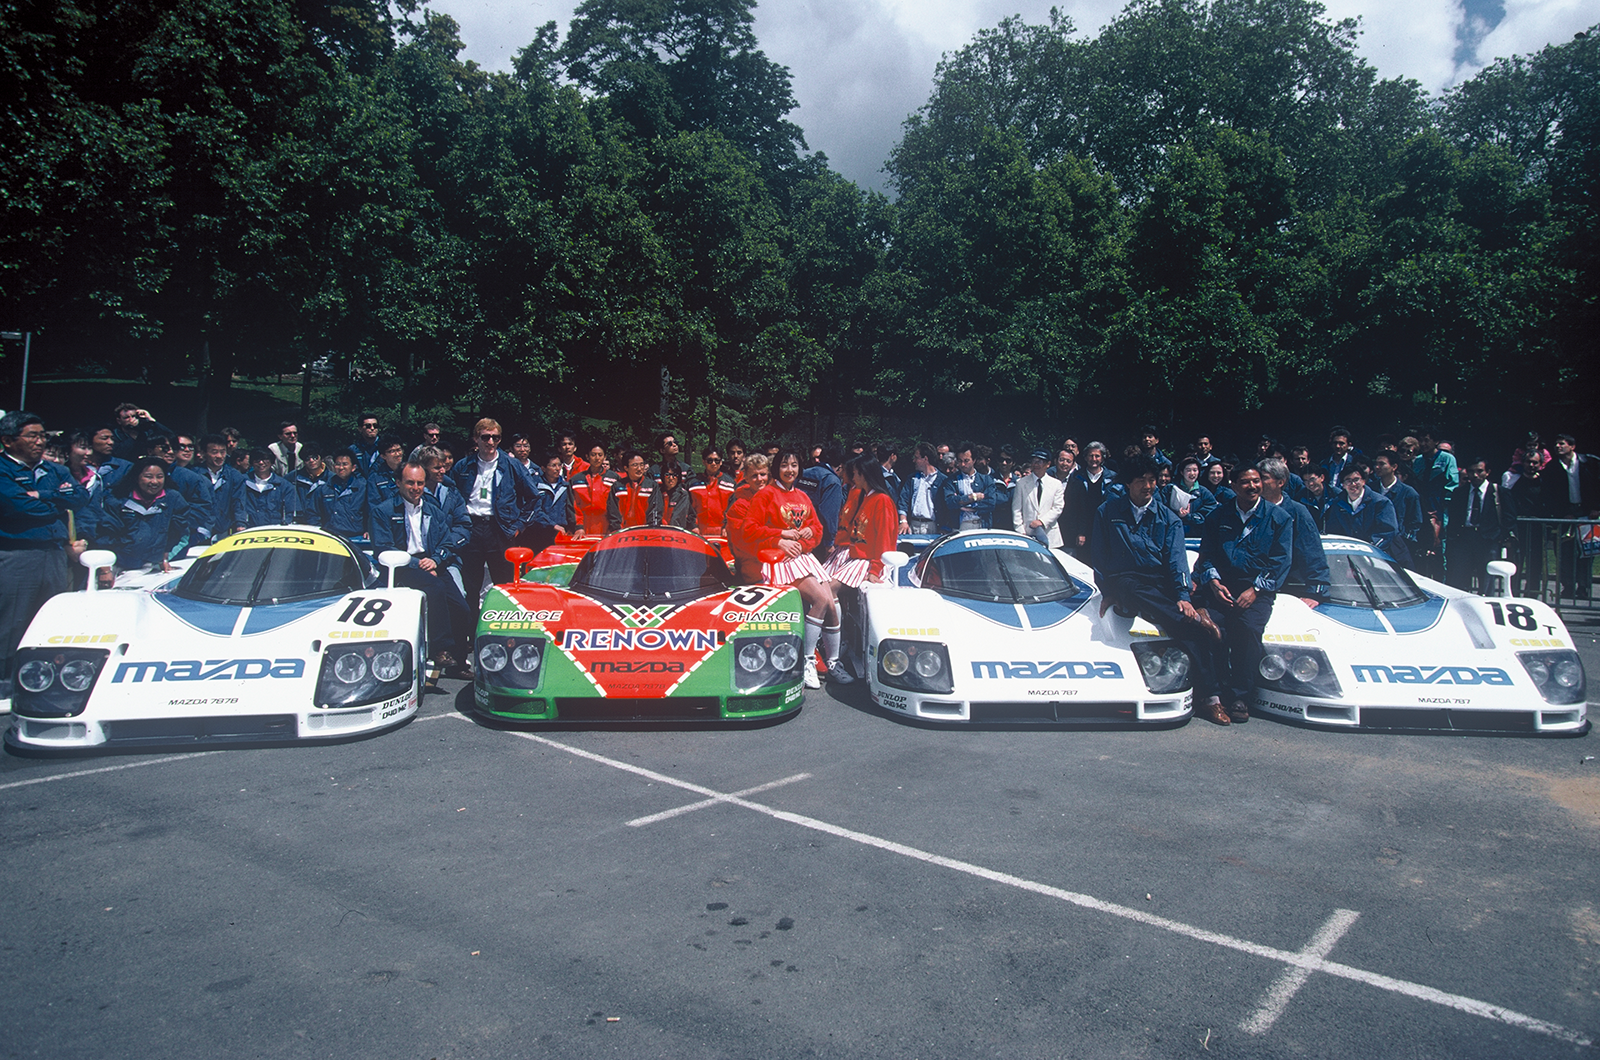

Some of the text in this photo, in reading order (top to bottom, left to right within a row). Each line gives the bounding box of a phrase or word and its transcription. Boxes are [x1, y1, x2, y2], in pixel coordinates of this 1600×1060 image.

[233, 536, 315, 546] mazda
[618, 535, 687, 544] mazda
[964, 538, 1029, 548] mazda
[1321, 543, 1374, 553] azda
[731, 587, 772, 605] 5
[337, 597, 392, 626] 18
[482, 610, 563, 621] CHARGE
[723, 611, 800, 623] CHARGE
[1485, 602, 1538, 631] 18
[1542, 624, 1556, 636] T
[563, 629, 719, 650] RENOWN
[111, 658, 306, 683] mazda
[590, 661, 685, 673] mazda
[971, 661, 1124, 679] mazda
[1350, 665, 1515, 686] mazda
[877, 690, 907, 703] DUNLOP
